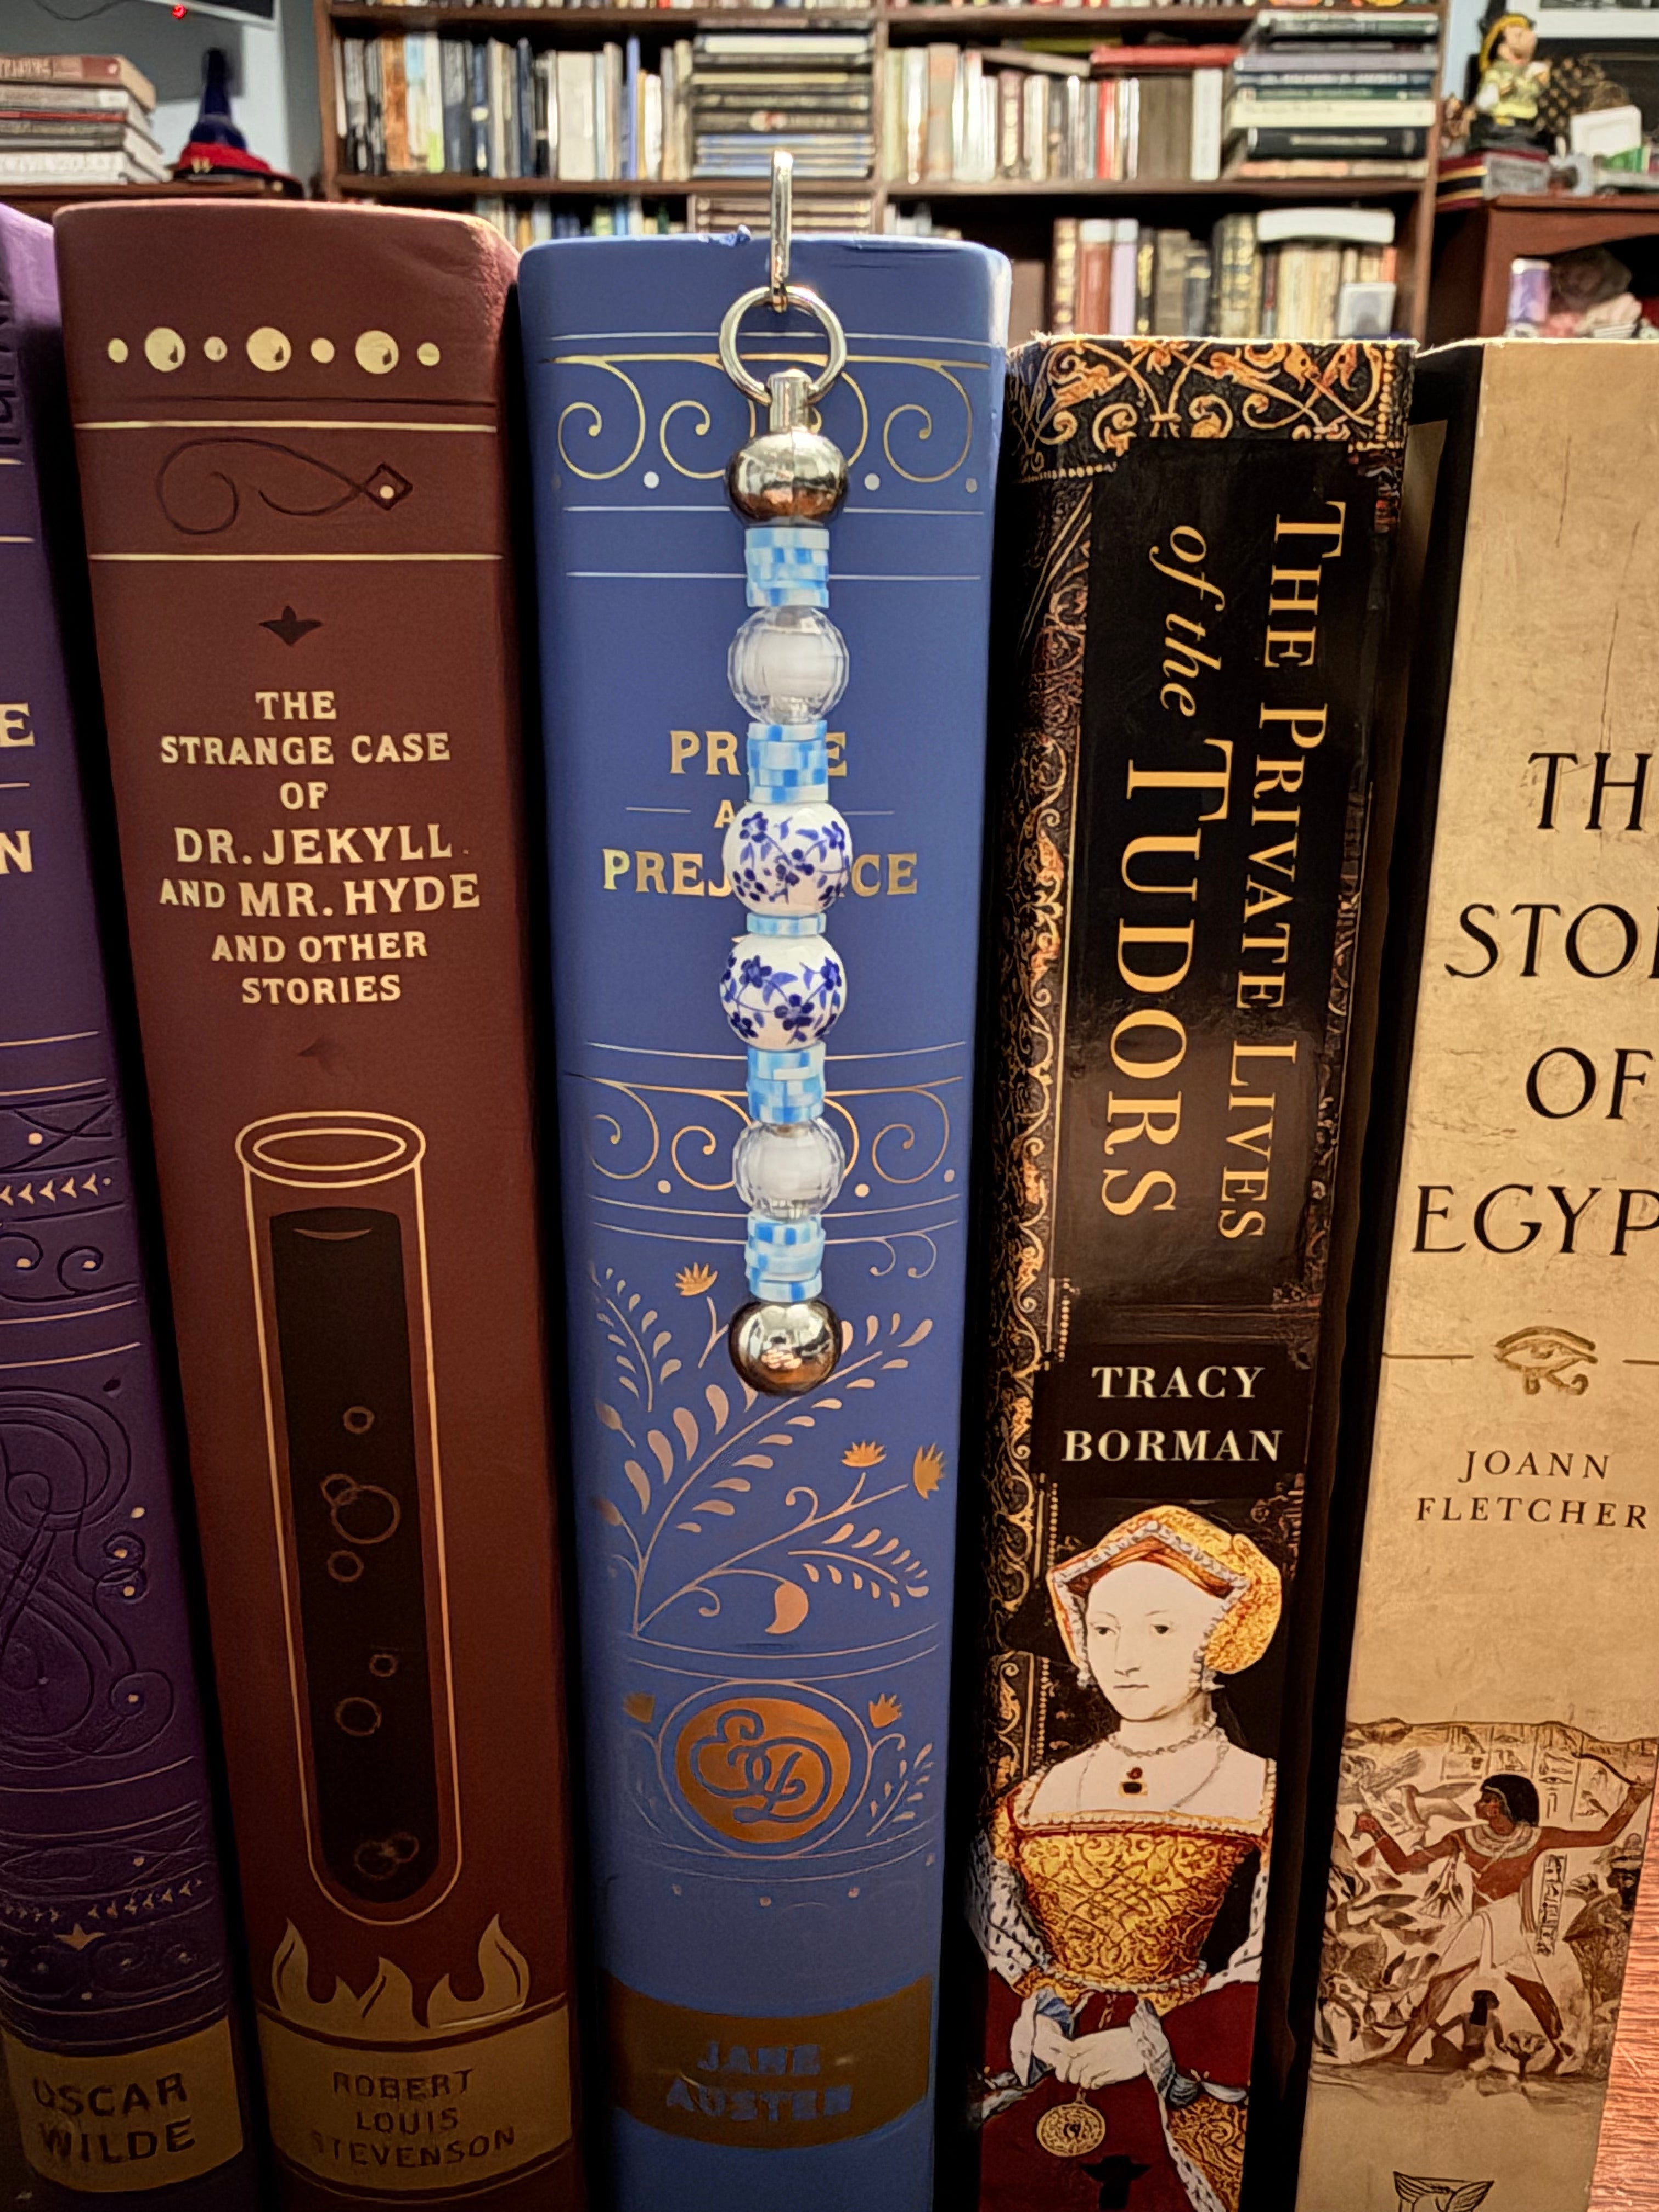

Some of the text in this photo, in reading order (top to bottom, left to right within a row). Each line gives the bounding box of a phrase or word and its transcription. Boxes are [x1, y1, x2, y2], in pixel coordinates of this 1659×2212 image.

[255, 690, 337, 720] THE
[160, 733, 450, 766] STRANGE CASE
[670, 731, 847, 777] PRE
[280, 781, 328, 810] OF
[174, 824, 452, 865] DR. JEKYLL
[603, 848, 917, 897] PREJCE
[1102, 525, 1234, 1216] of the TUDORS
[1218, 500, 1346, 1239] THE PRIVATE LIVES
[159, 873, 480, 917] AND MR. HYDE
[212, 930, 428, 962] AND OTHER
[1444, 903, 1659, 979] STO
[241, 974, 401, 1005] STORIES
[1526, 1047, 1653, 1120] OF
[1092, 1365, 1265, 1398] TRACY
[1061, 1429, 1284, 1462] BORMAN
[1457, 1449, 1610, 1483] JOANN
[1416, 1496, 1647, 1529] FLETCHER
[333, 2068, 473, 2101] ROBERT
[356, 2107, 459, 2135] LOUIS
[38, 2115, 196, 2164] WILDE
